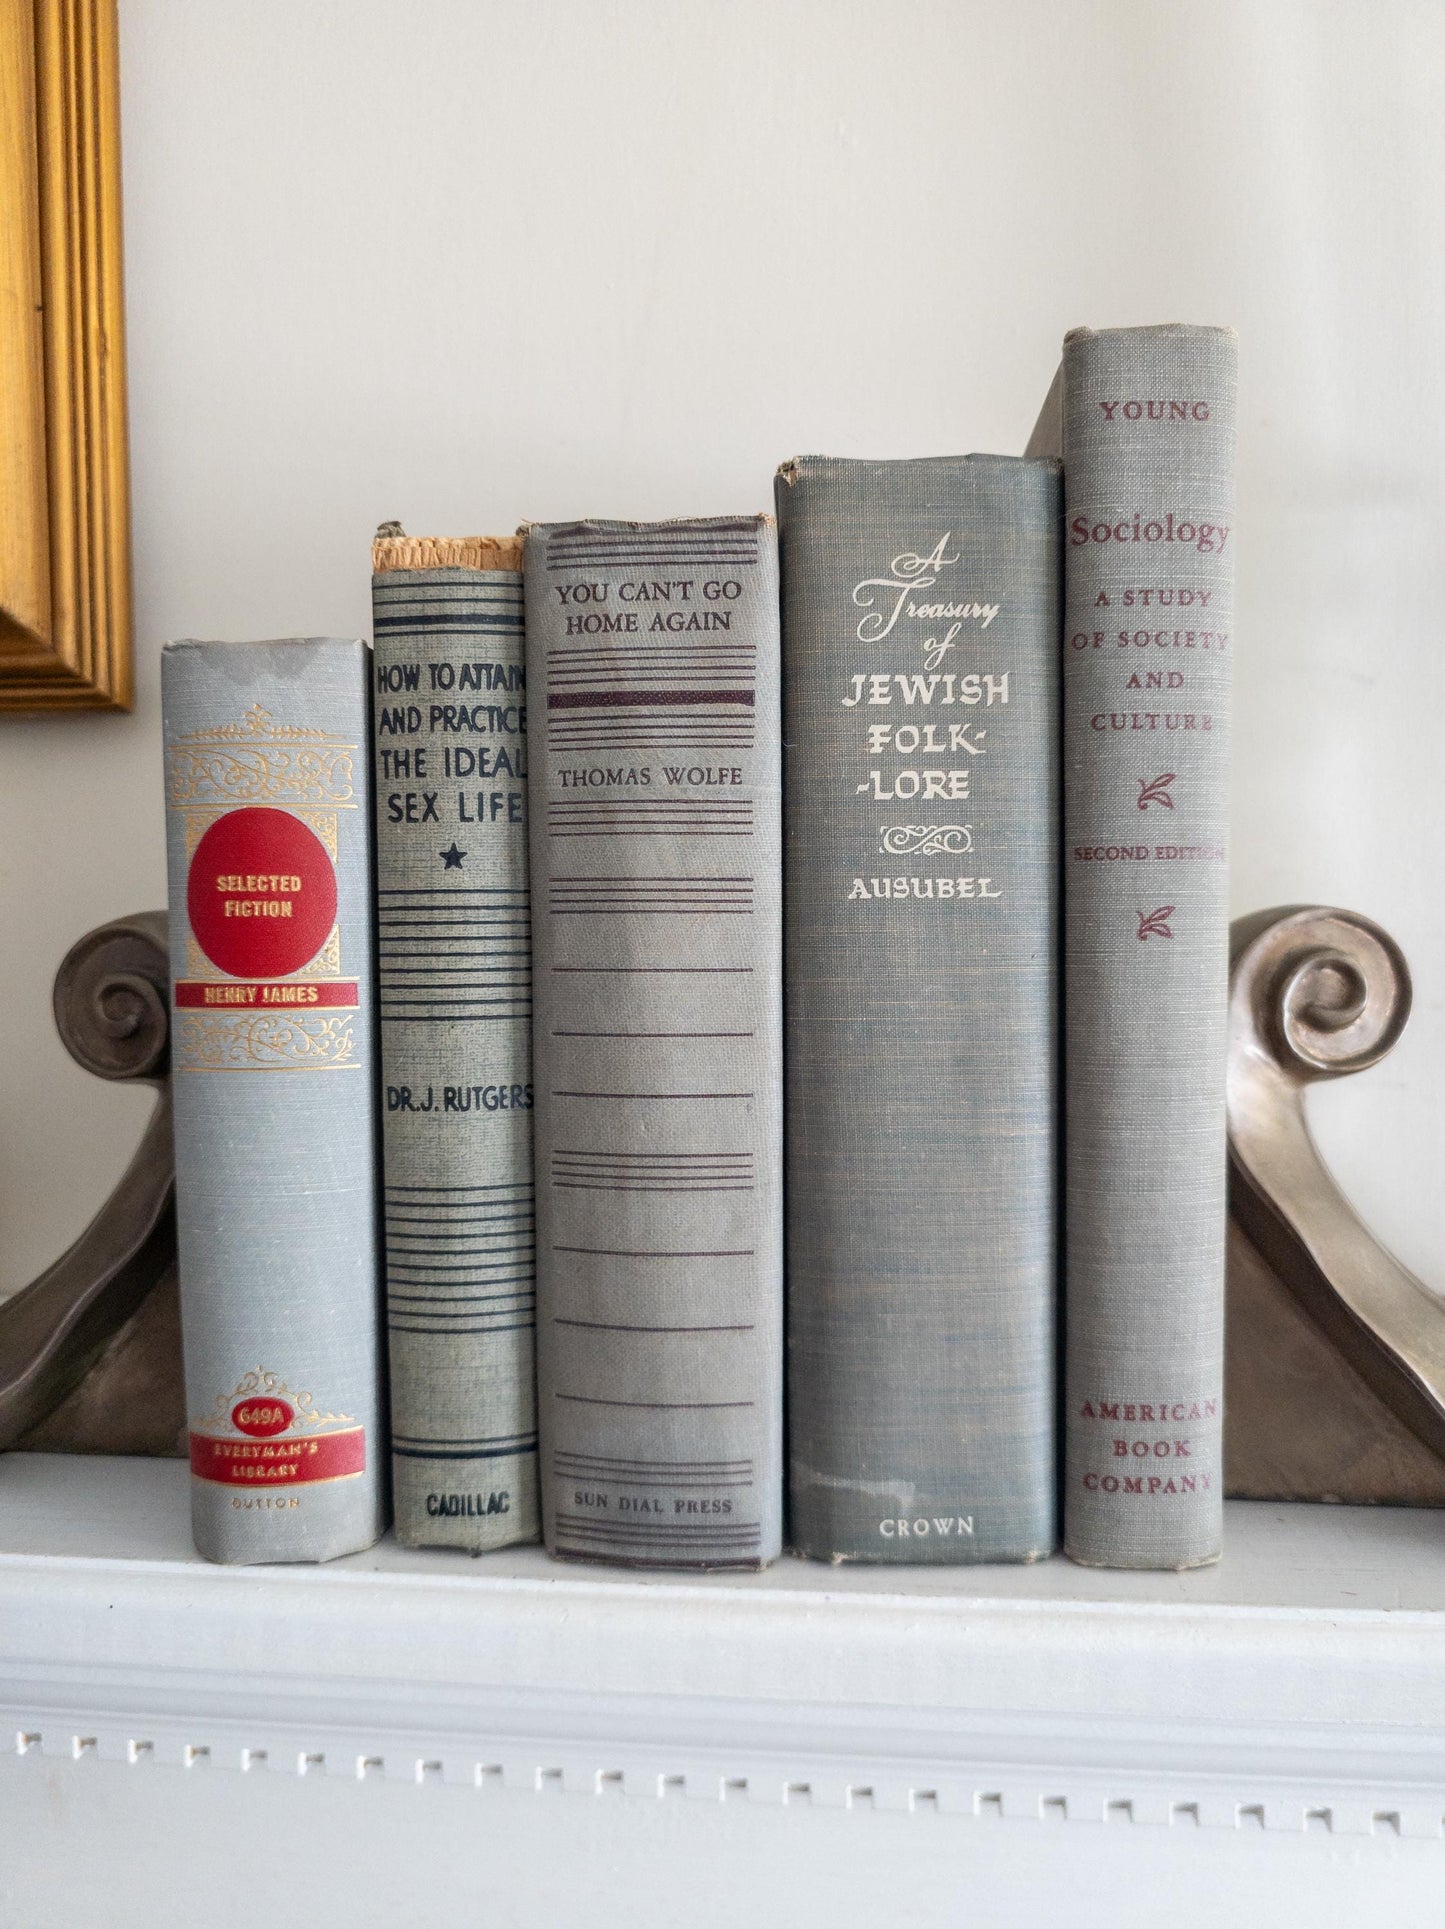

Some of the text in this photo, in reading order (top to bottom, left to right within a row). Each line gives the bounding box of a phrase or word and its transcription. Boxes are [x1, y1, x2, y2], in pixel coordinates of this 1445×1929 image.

[1100, 401, 1210, 421] YOUNG
[1071, 513, 1229, 554] Sociology
[891, 532, 960, 578] A
[555, 580, 742, 605] YOU CAN'T GO
[1094, 589, 1211, 607] A STUDY
[853, 577, 1000, 642] Treasury
[566, 612, 731, 635] HOME AGAIN
[924, 622, 962, 671] of
[1072, 631, 1228, 650] OF SOCIETY
[378, 663, 526, 693] HOW TO ATTAIN
[1126, 672, 1184, 688] AND
[842, 672, 1010, 706] JEWISH
[379, 705, 527, 735] AND PRACTICE
[1091, 713, 1213, 731] CULTURE
[381, 747, 528, 779] THE IDEAL
[558, 767, 742, 787] THOMAS WOLFE
[388, 791, 523, 823] SEX LIFE
[1073, 846, 1225, 861] SECOND EDITN
[217, 875, 302, 892] SELECTED
[849, 877, 1004, 899] AUSUBEL
[224, 900, 293, 917] FICTION
[204, 986, 319, 1004] HENRY JAMES
[444, 1084, 534, 1112] RUTGERS
[239, 1406, 284, 1424] 649A
[1081, 1399, 1217, 1421] AMERICAN
[214, 1441, 318, 1457] EVERYMAN'S
[1113, 1440, 1191, 1457] BOOK
[232, 1463, 298, 1478] LIBRARY
[1082, 1473, 1212, 1494] COMPANY
[231, 1498, 299, 1510] DUTTON
[427, 1490, 510, 1516] CADILLAC
[574, 1491, 733, 1513] SUN DIAL PRESS
[880, 1516, 974, 1536] CROWN
